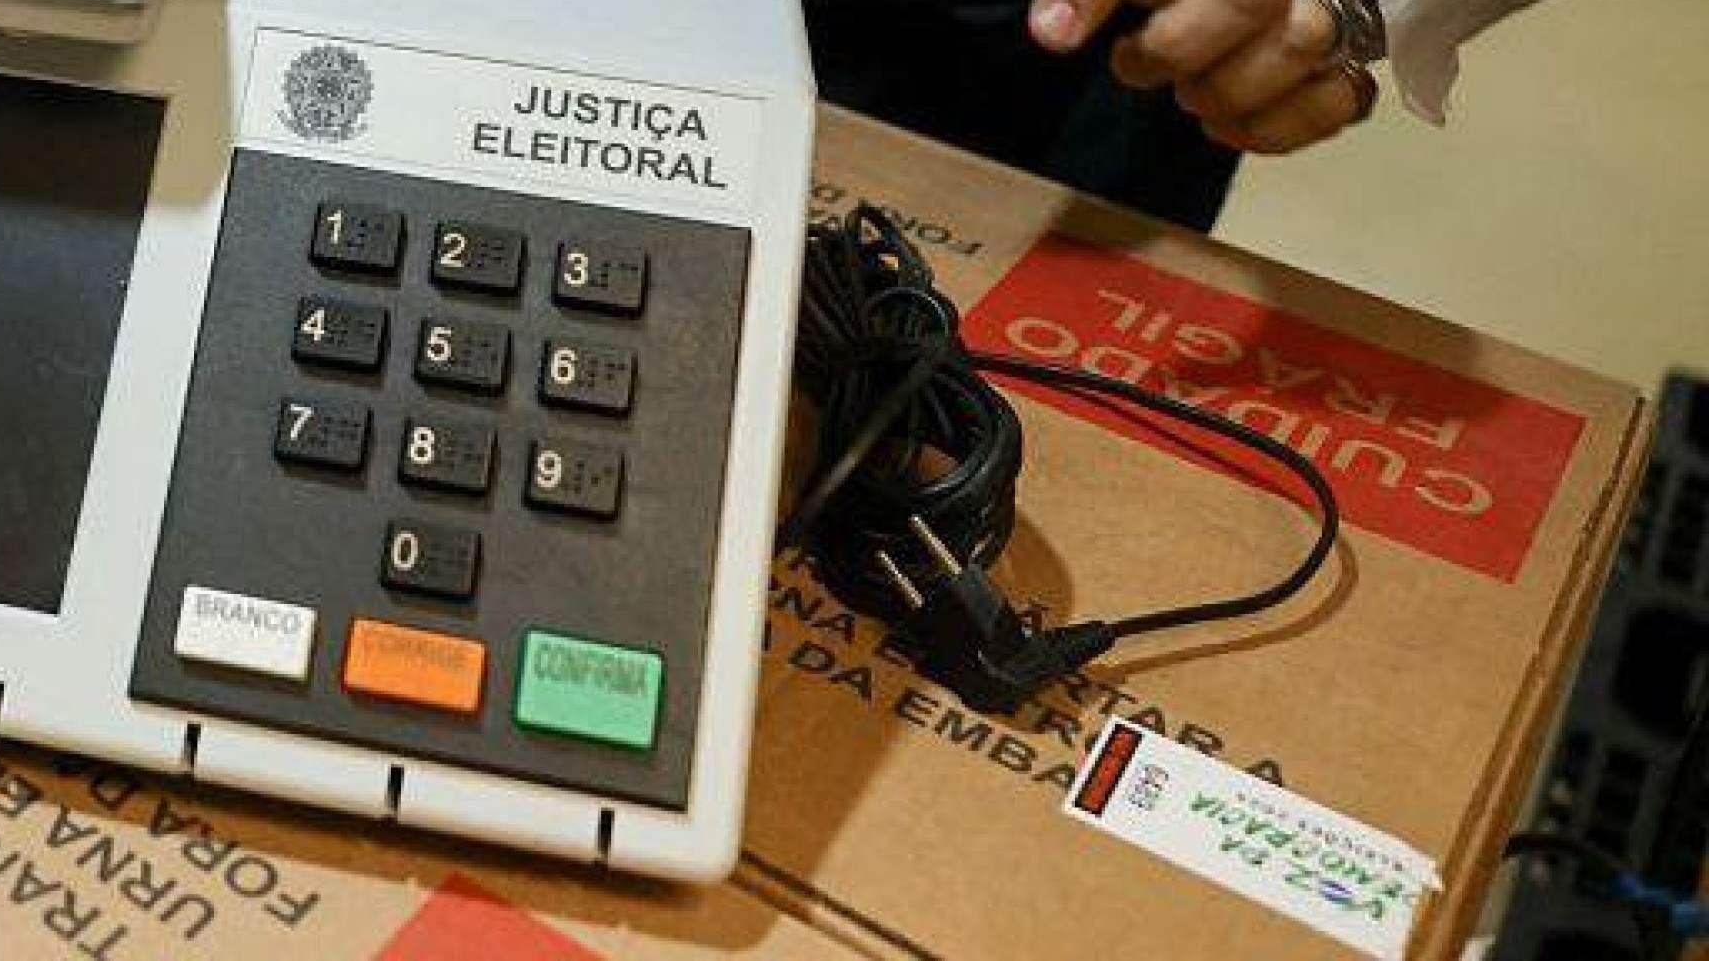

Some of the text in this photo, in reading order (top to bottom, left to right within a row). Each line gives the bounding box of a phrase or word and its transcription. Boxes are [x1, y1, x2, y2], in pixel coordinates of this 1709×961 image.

[514, 85, 708, 142] JUSTIÇA
[472, 122, 728, 189] ELEITORAL
[326, 208, 344, 244] 1
[439, 233, 466, 268] 2
[564, 254, 589, 287] 3
[300, 308, 325, 341] 4
[427, 328, 453, 362] 5
[550, 349, 576, 384] 6
[288, 406, 313, 439] 7
[409, 428, 435, 464] 8
[536, 453, 562, 487] 9
[391, 534, 419, 570] 0
[195, 593, 301, 636] BRANCO
[534, 642, 648, 694] CONFIRMA
[791, 643, 875, 705] DA
[47, 803, 215, 940] URNA
[149, 797, 320, 927] FORA
